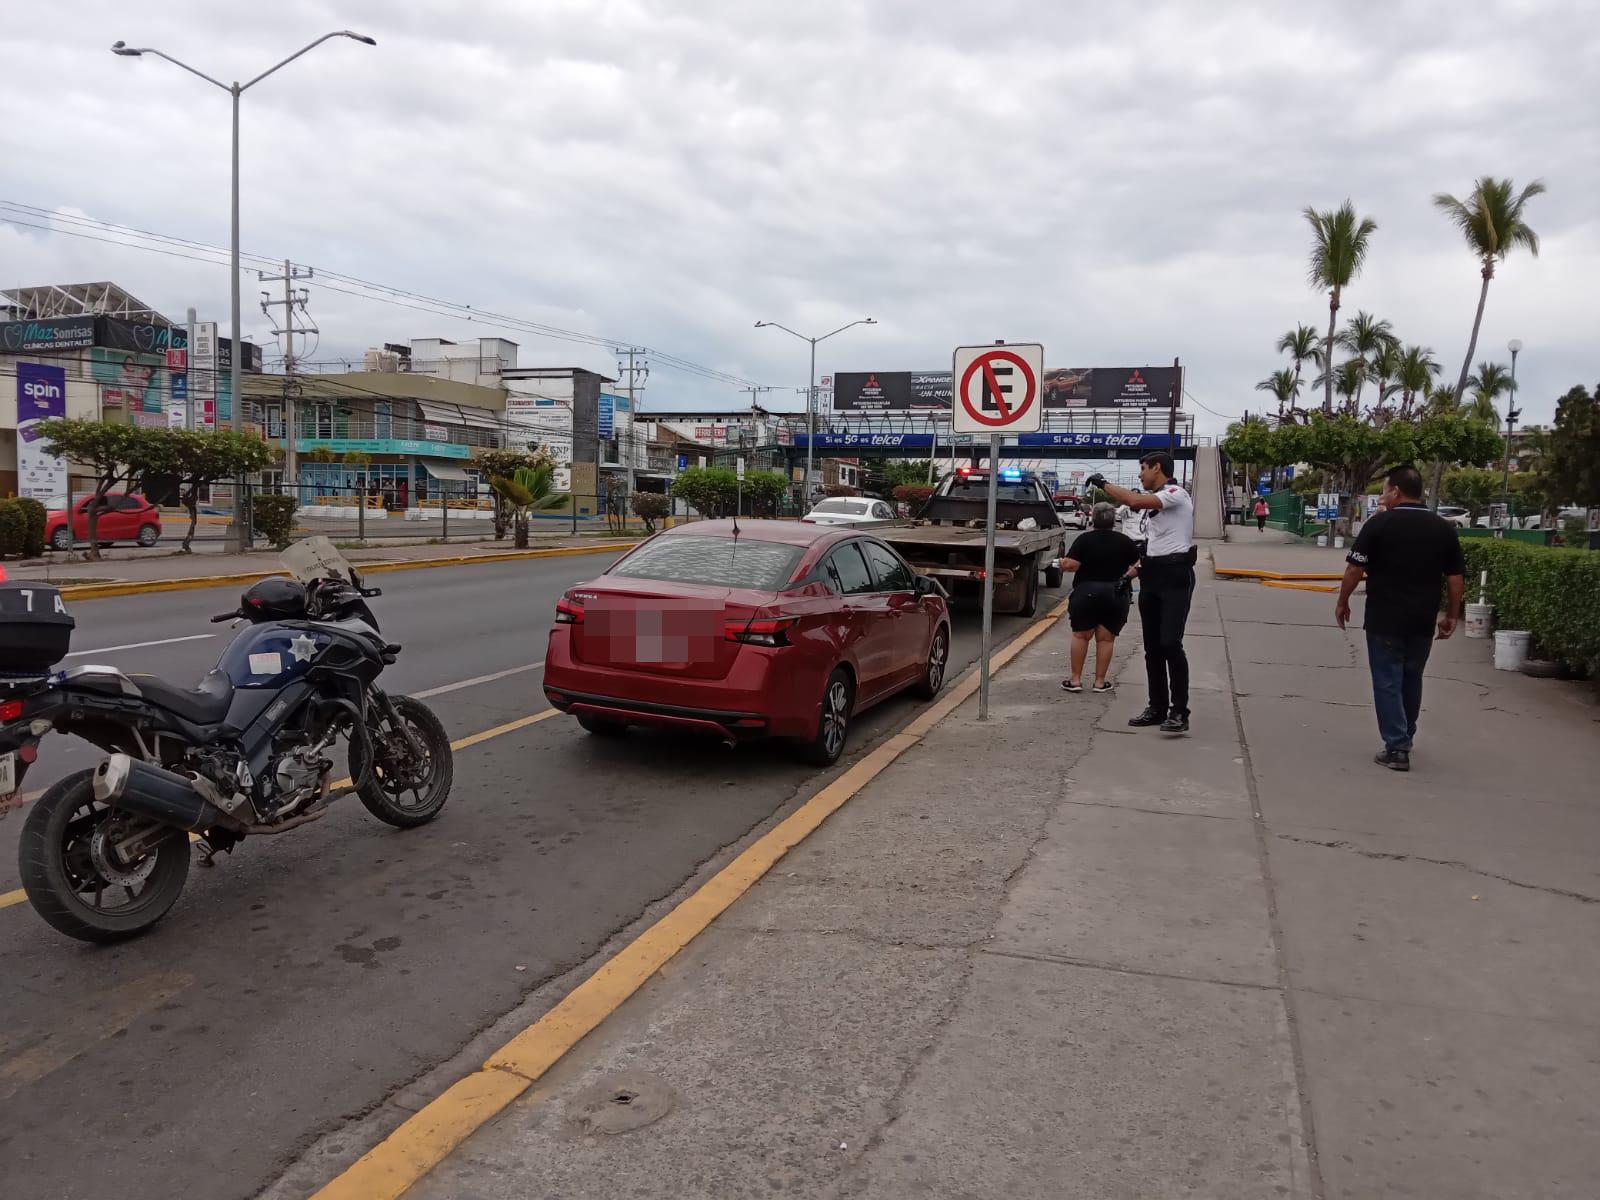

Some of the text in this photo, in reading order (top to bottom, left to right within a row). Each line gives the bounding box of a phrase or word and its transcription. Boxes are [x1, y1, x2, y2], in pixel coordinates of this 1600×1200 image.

[55, 339, 93, 348] DENTALES
[24, 382, 60, 400] spin
[982, 367, 1013, 410] E
[844, 434, 858, 444] 5G
[871, 434, 904, 445] telcel
[1074, 434, 1090, 445] 5G
[1105, 434, 1143, 446] telcel
[20, 590, 67, 614] 7 A
